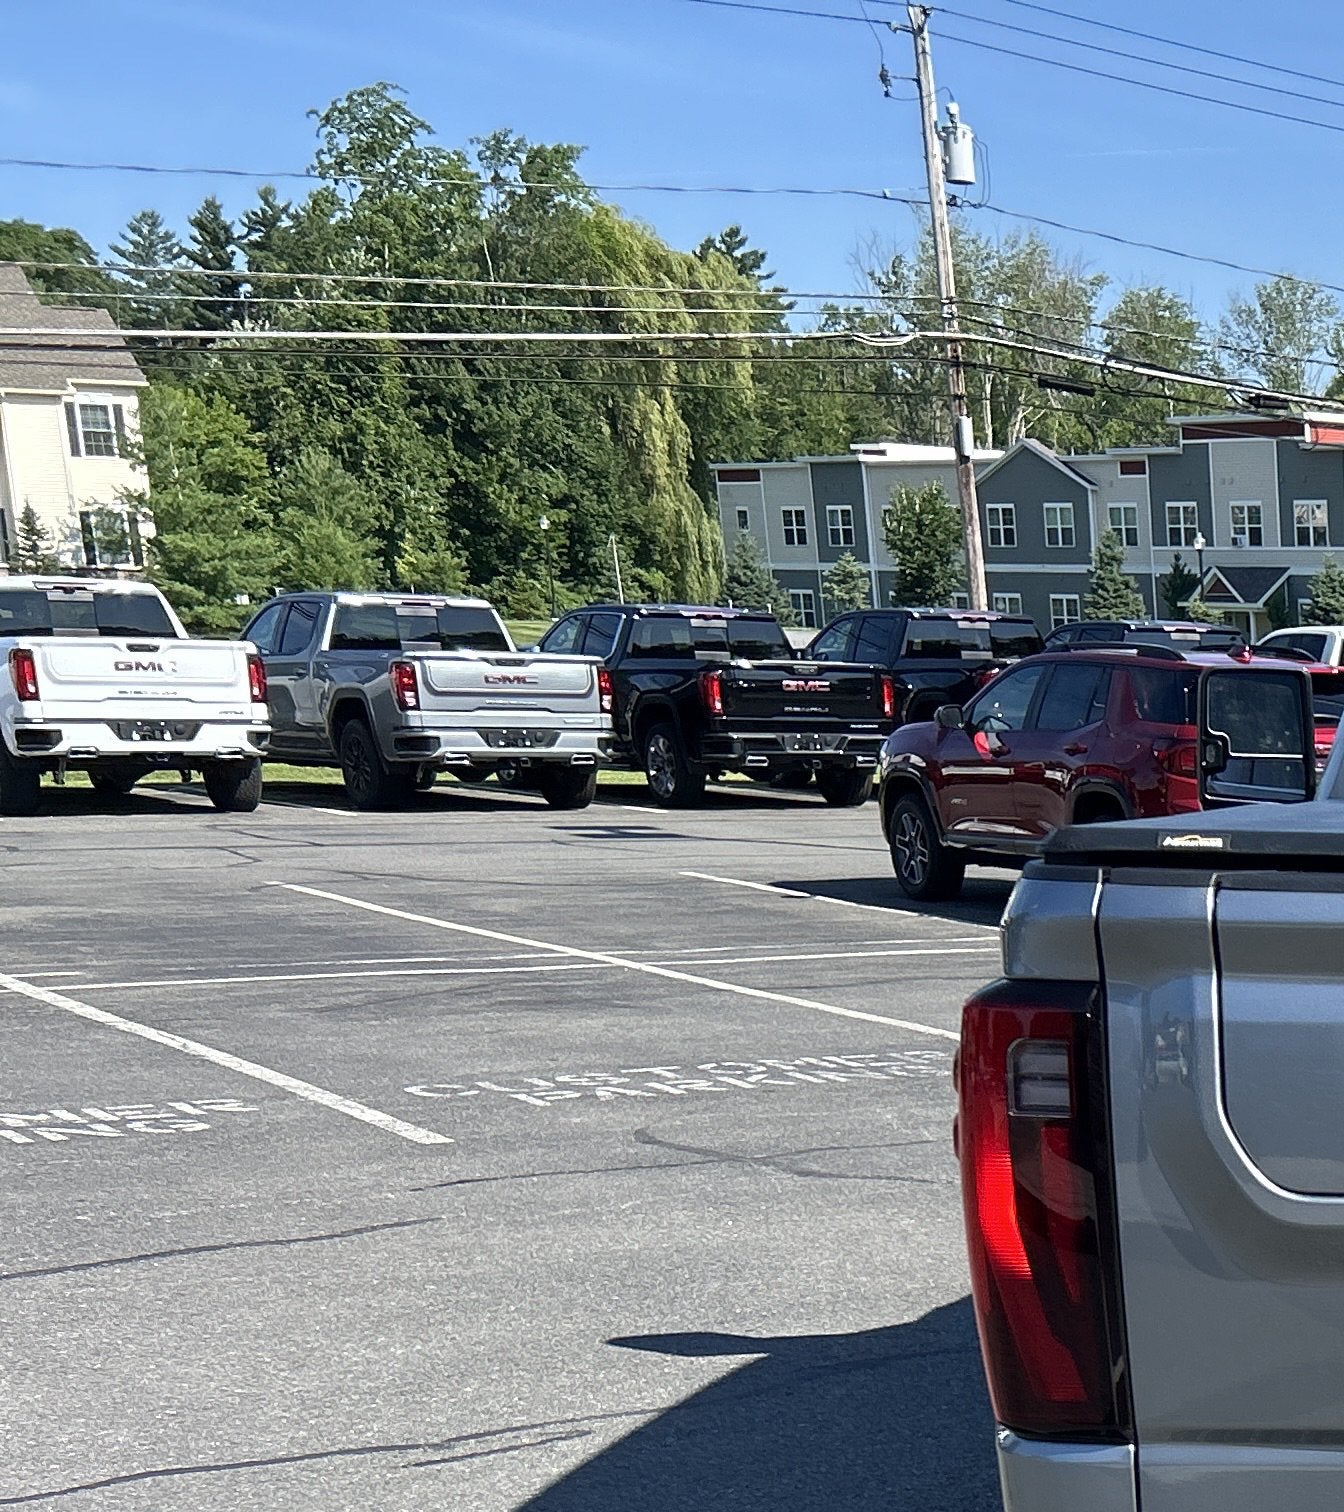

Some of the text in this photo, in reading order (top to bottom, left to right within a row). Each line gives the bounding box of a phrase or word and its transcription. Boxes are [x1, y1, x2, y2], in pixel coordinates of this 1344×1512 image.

[483, 673, 539, 684] GMC
[782, 679, 831, 692] GMC
[403, 1050, 952, 1098] CUSTOMER
